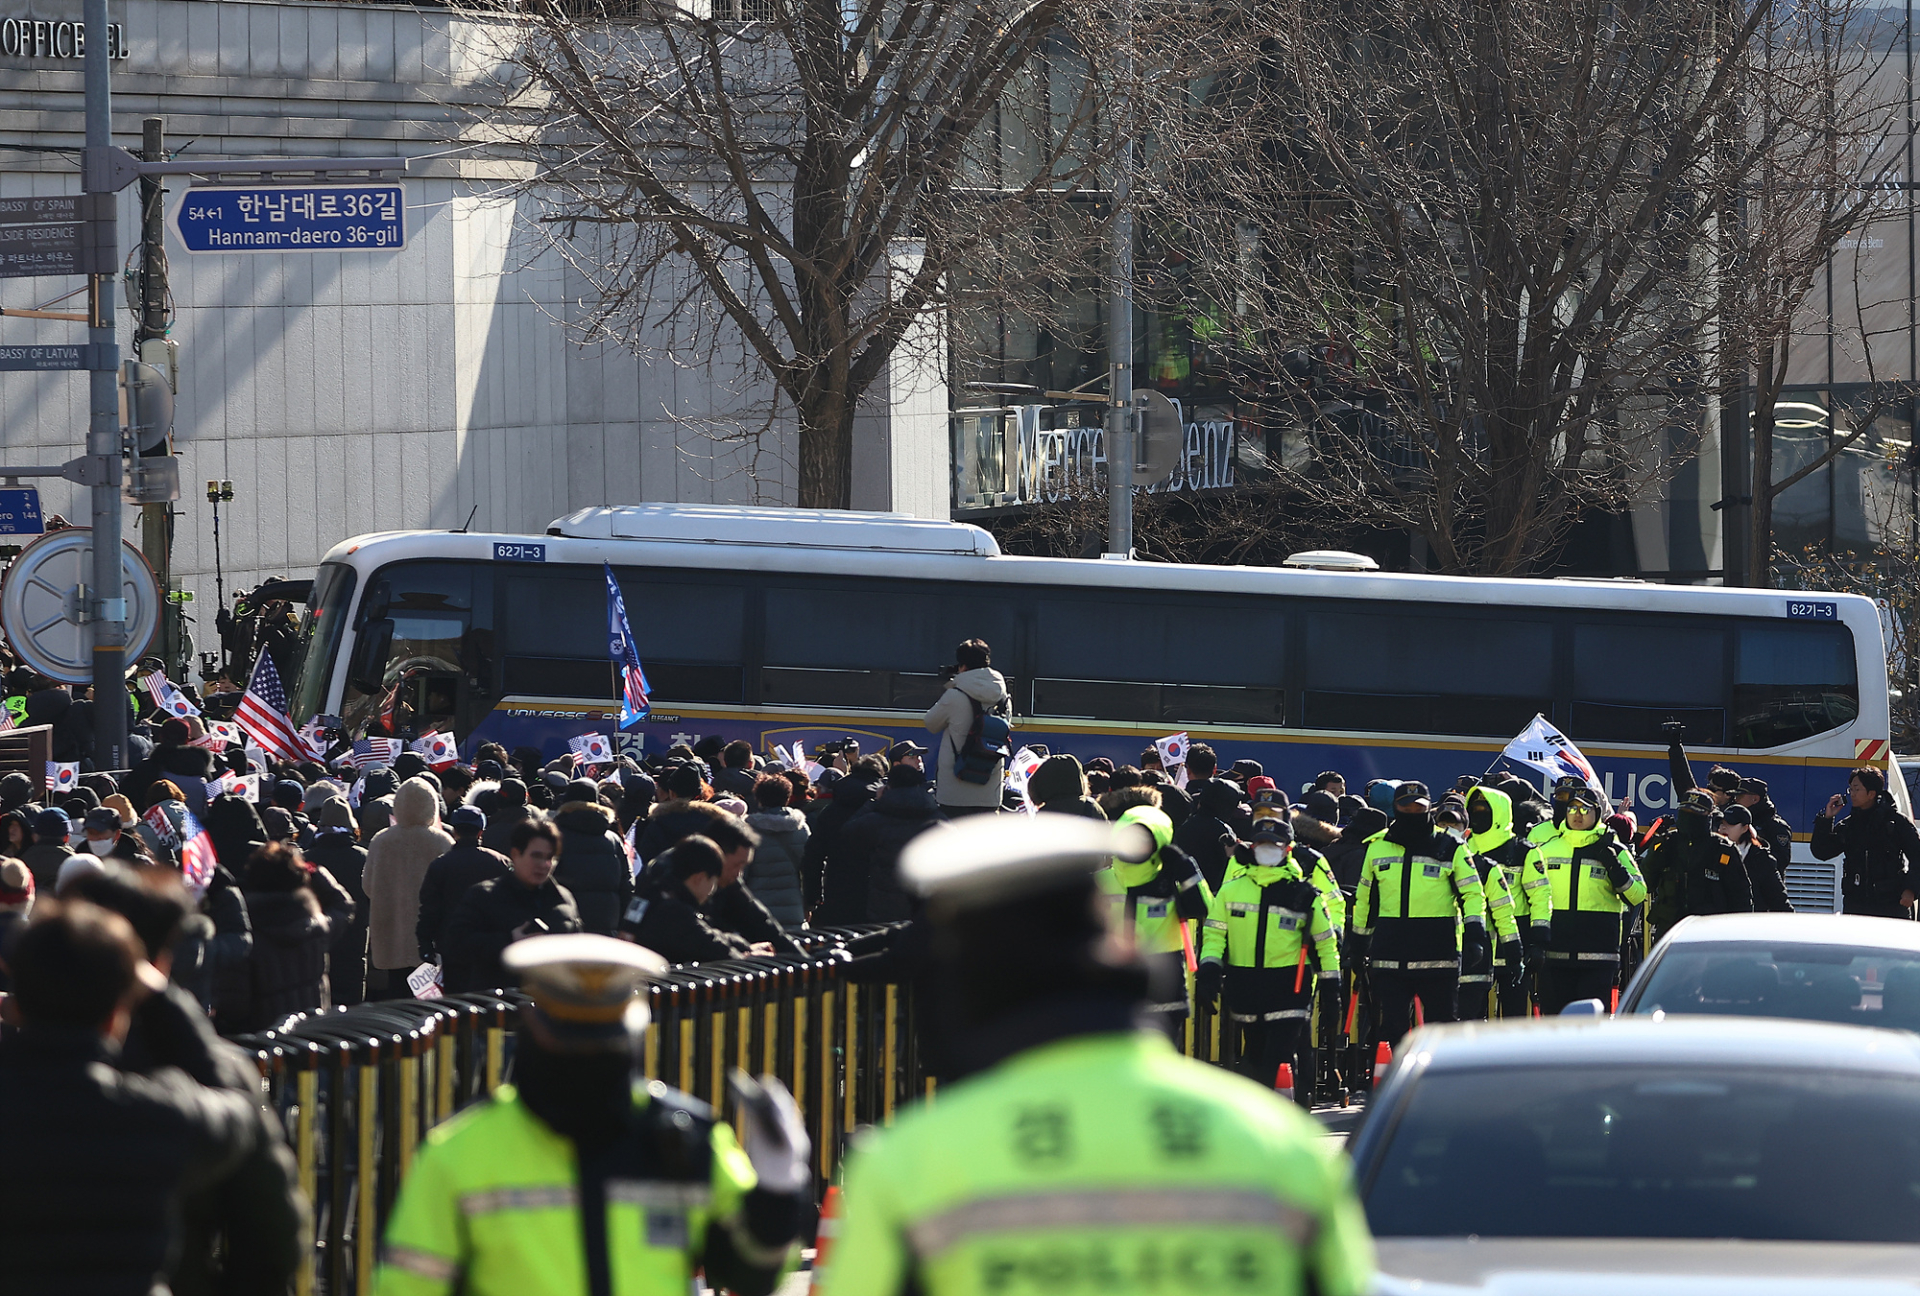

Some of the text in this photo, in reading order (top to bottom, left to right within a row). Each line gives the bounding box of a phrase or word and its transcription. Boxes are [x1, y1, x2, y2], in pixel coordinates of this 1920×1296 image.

[3, 18, 131, 59] OFFICEEL
[33, 201, 45, 211] OF
[48, 199, 75, 211] SPAIN
[237, 192, 397, 222] 한남대로36길
[26, 227, 75, 240] RESIDENCE
[208, 226, 398, 246] Hannam-daero 36-gil
[8, 253, 44, 264] 파트너스
[47, 251, 74, 262] 하우스
[31, 348, 43, 359] OF
[46, 348, 80, 359] LATVIA
[22, 511, 38, 520] 144
[651, 714, 679, 723] ELEGANCE
